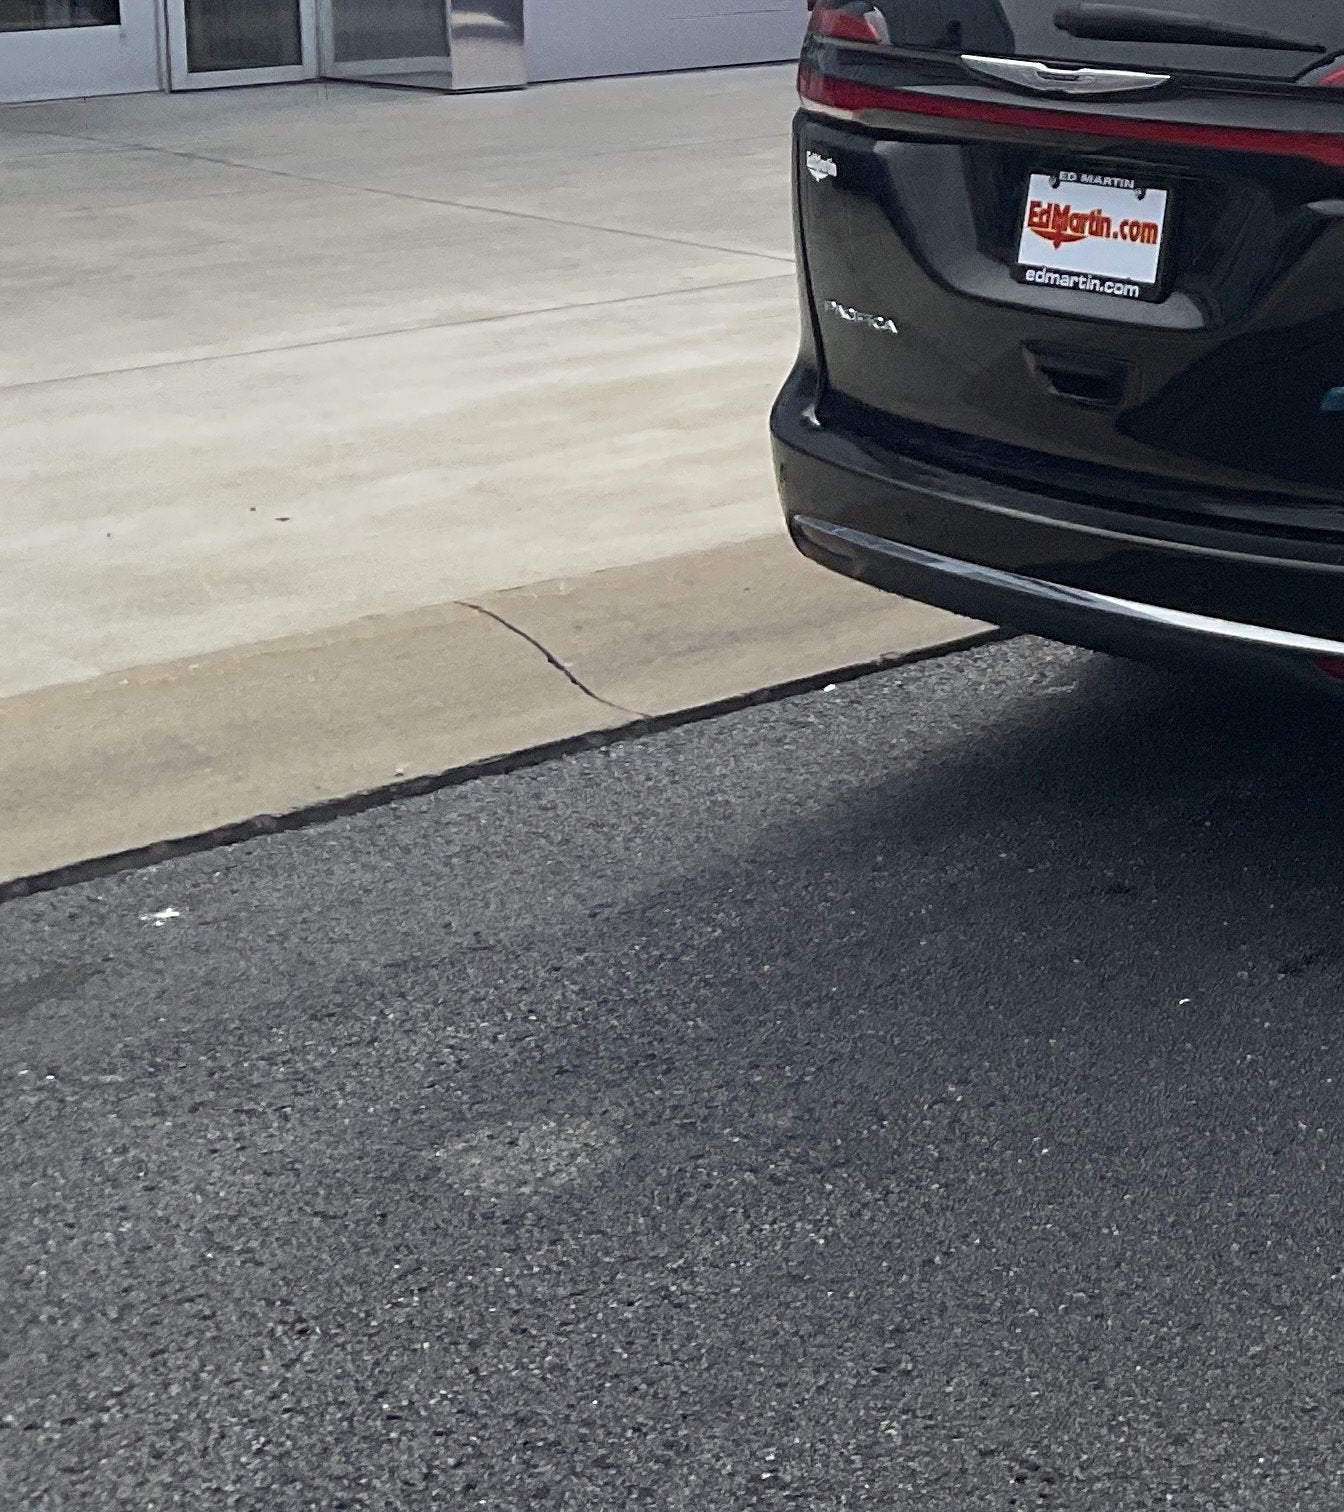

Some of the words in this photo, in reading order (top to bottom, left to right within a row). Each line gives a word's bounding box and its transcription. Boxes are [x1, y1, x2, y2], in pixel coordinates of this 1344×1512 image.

[1059, 171, 1077, 181] ED
[1080, 174, 1135, 188] MARTIN
[1027, 200, 1159, 245] EdMartin.com
[1025, 266, 1140, 298] edmartin.com
